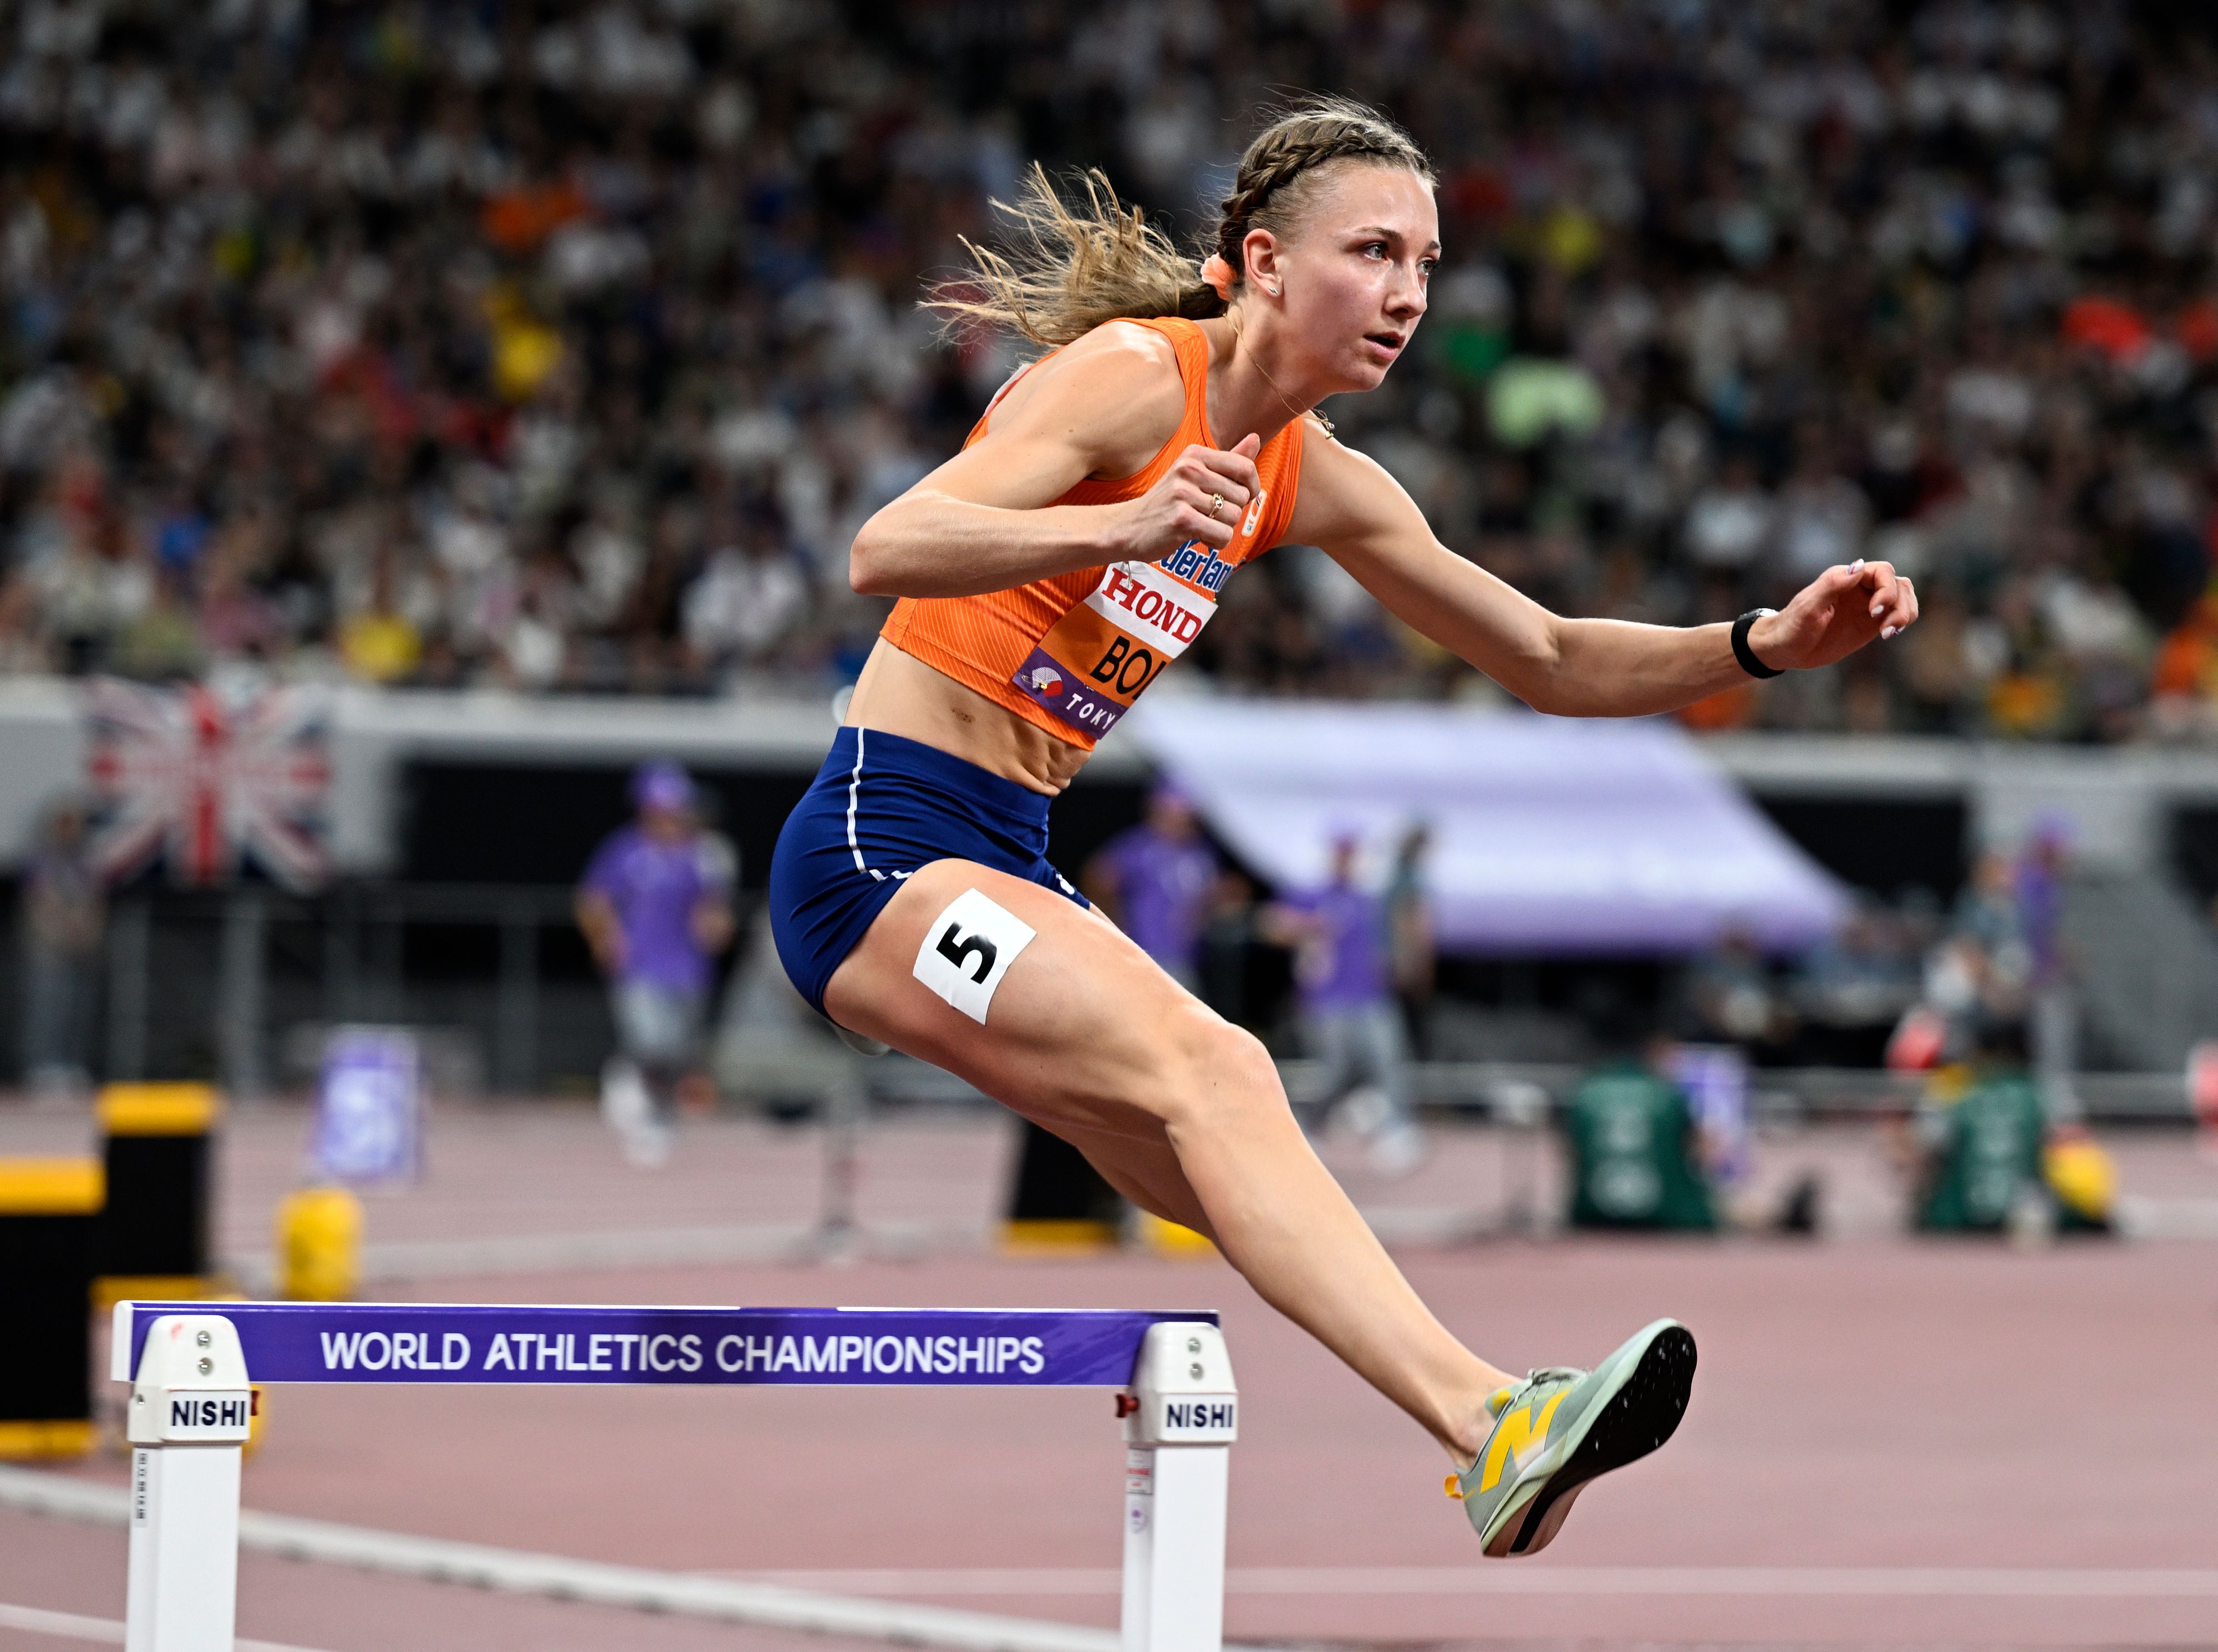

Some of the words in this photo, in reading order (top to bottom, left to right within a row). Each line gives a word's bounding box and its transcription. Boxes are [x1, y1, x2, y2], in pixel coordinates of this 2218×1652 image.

[1160, 540, 1235, 591] derlan
[1102, 567, 1202, 643] HOND
[1090, 635, 1167, 700] BO
[1066, 693, 1116, 729] TOKY
[936, 920, 997, 984] 5
[320, 1331, 471, 1370] WORLD
[483, 1333, 703, 1371] ATHLETICS
[715, 1335, 1045, 1374] CHAMPIONSHIPS
[171, 1400, 246, 1426] NISHI
[1166, 1404, 1233, 1427] NISHI
